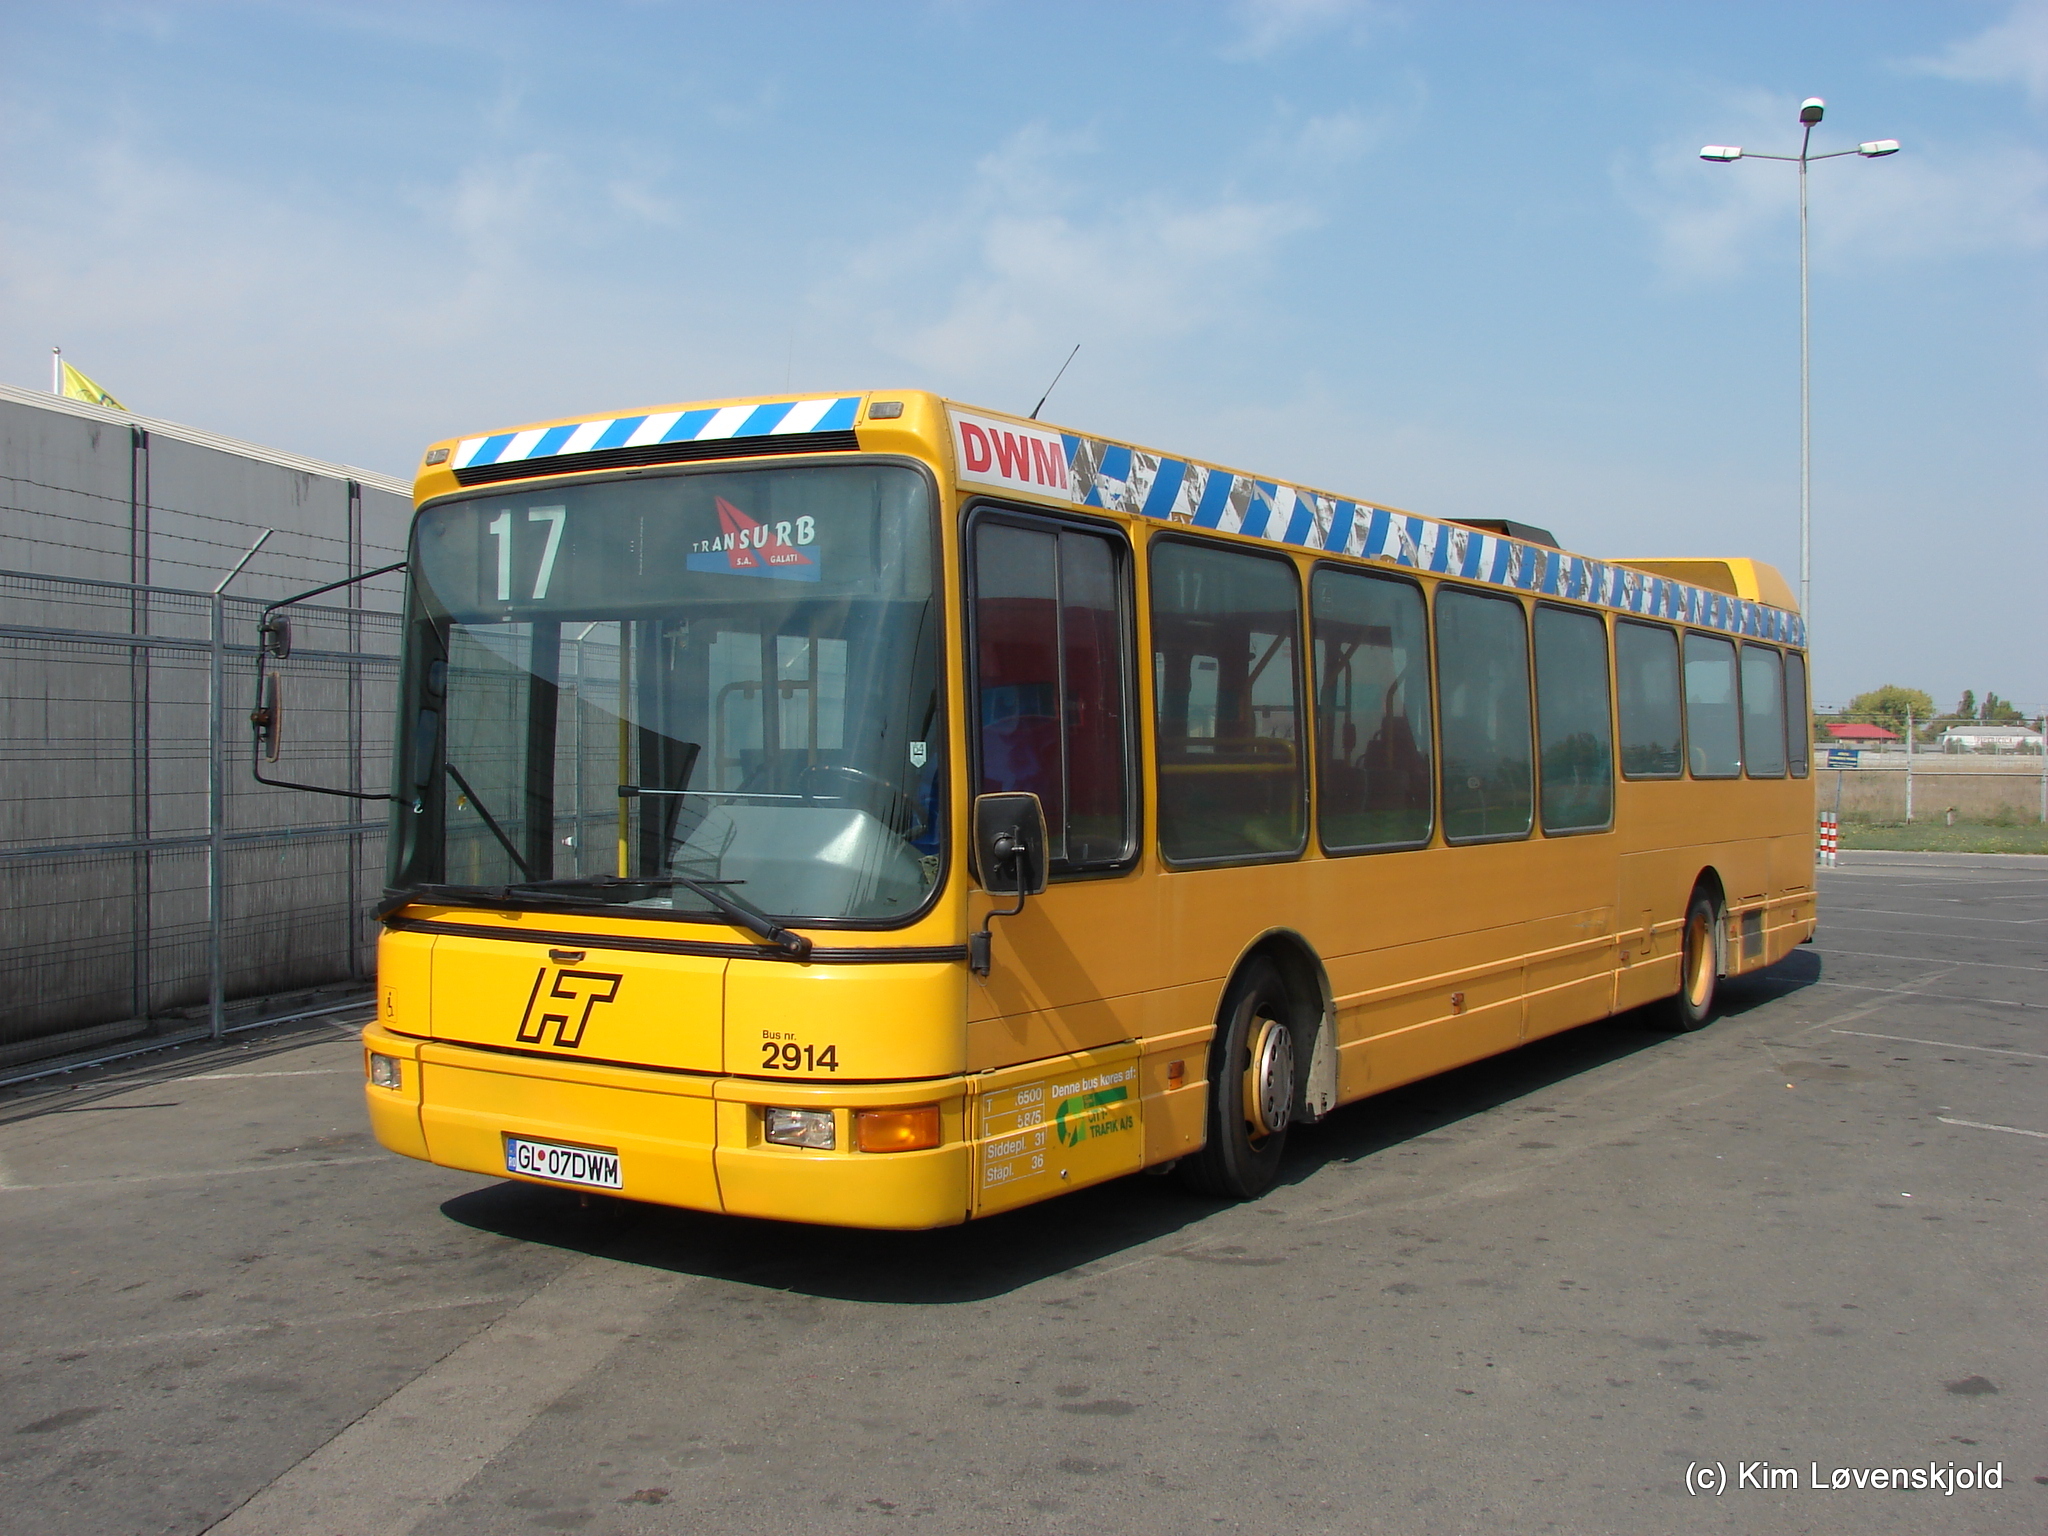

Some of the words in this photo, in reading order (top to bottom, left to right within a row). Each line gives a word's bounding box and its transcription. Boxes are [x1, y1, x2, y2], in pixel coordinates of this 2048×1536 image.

[959, 421, 1068, 490] DWM
[692, 515, 816, 552] TRANSURB
[489, 504, 567, 600] 17
[736, 557, 752, 566] S.A.
[770, 554, 798, 564] GALATI
[762, 1029, 781, 1040] Bus
[784, 1032, 797, 1041] nr.
[762, 1041, 839, 1072] 2914
[1052, 1084, 1080, 1098] Denne
[1082, 1078, 1099, 1091] bus
[1125, 1066, 1137, 1080] af:
[986, 1098, 994, 1113] T
[985, 1122, 992, 1137] L
[1090, 1119, 1119, 1138] TRAFIK
[1120, 1115, 1134, 1132] A/S
[988, 1136, 1027, 1159] Siddepl.
[1034, 1131, 1046, 1147] 31
[518, 1144, 541, 1172] GL
[548, 1149, 619, 1184] 07DWM
[1031, 1153, 1044, 1170] 36
